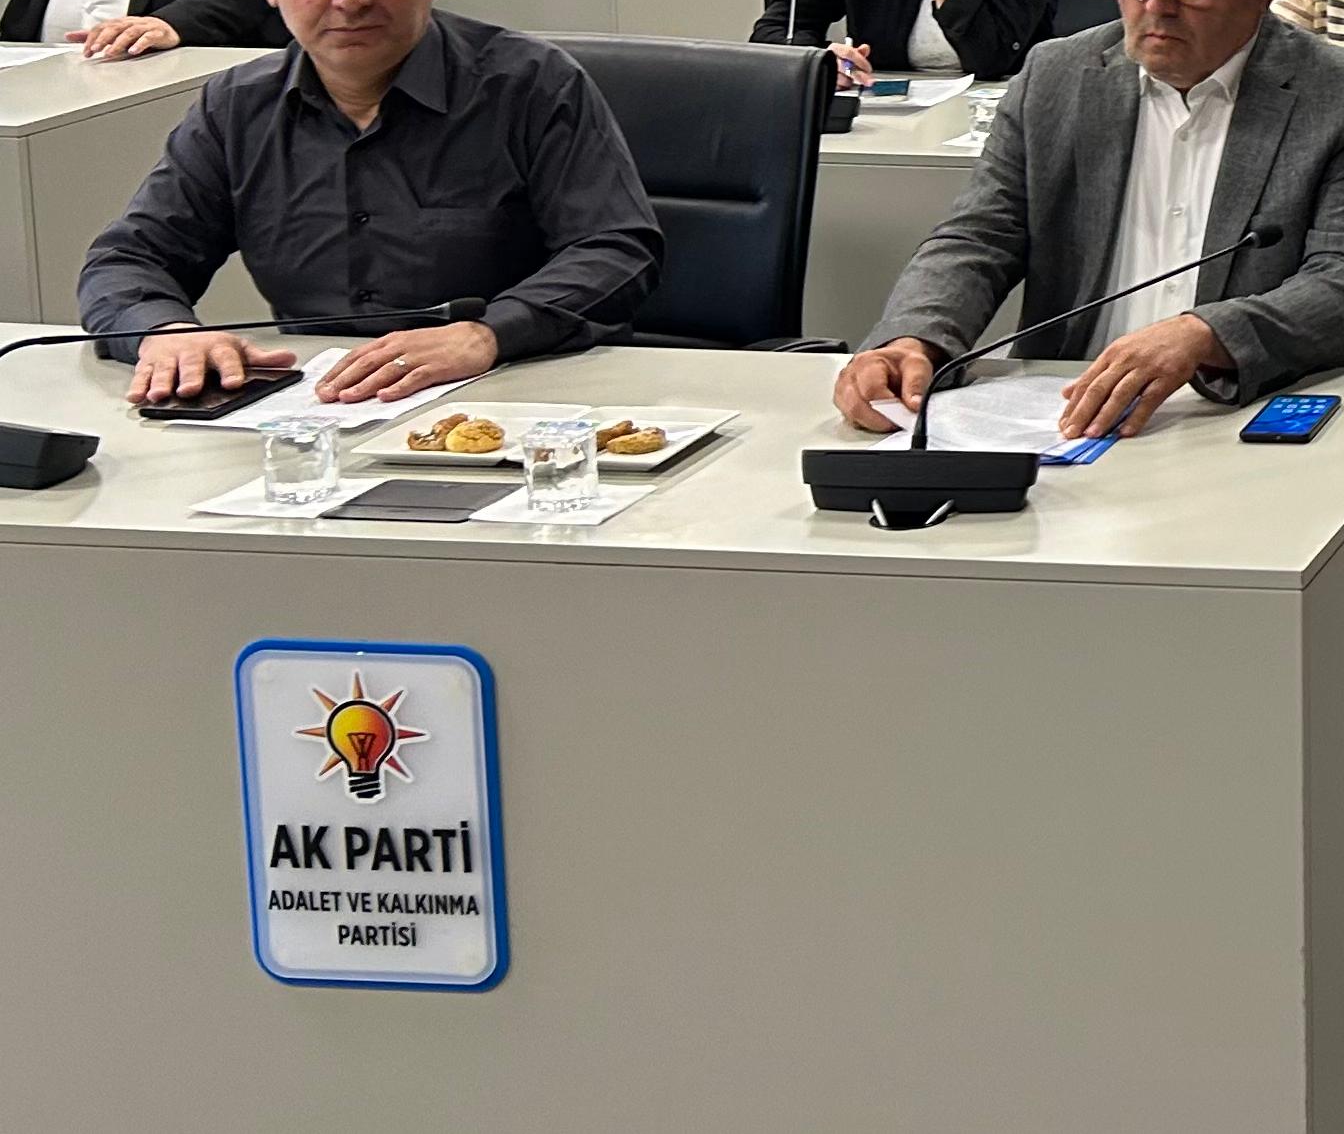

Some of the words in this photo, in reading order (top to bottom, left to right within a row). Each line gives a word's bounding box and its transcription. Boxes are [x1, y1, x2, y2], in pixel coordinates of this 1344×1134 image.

[269, 824, 332, 870] AK
[344, 821, 473, 874] PARTİ
[268, 890, 341, 912] ADALET
[347, 892, 372, 913] VE
[377, 893, 479, 916] KALKINMA
[337, 922, 417, 947] PARTİSİ
